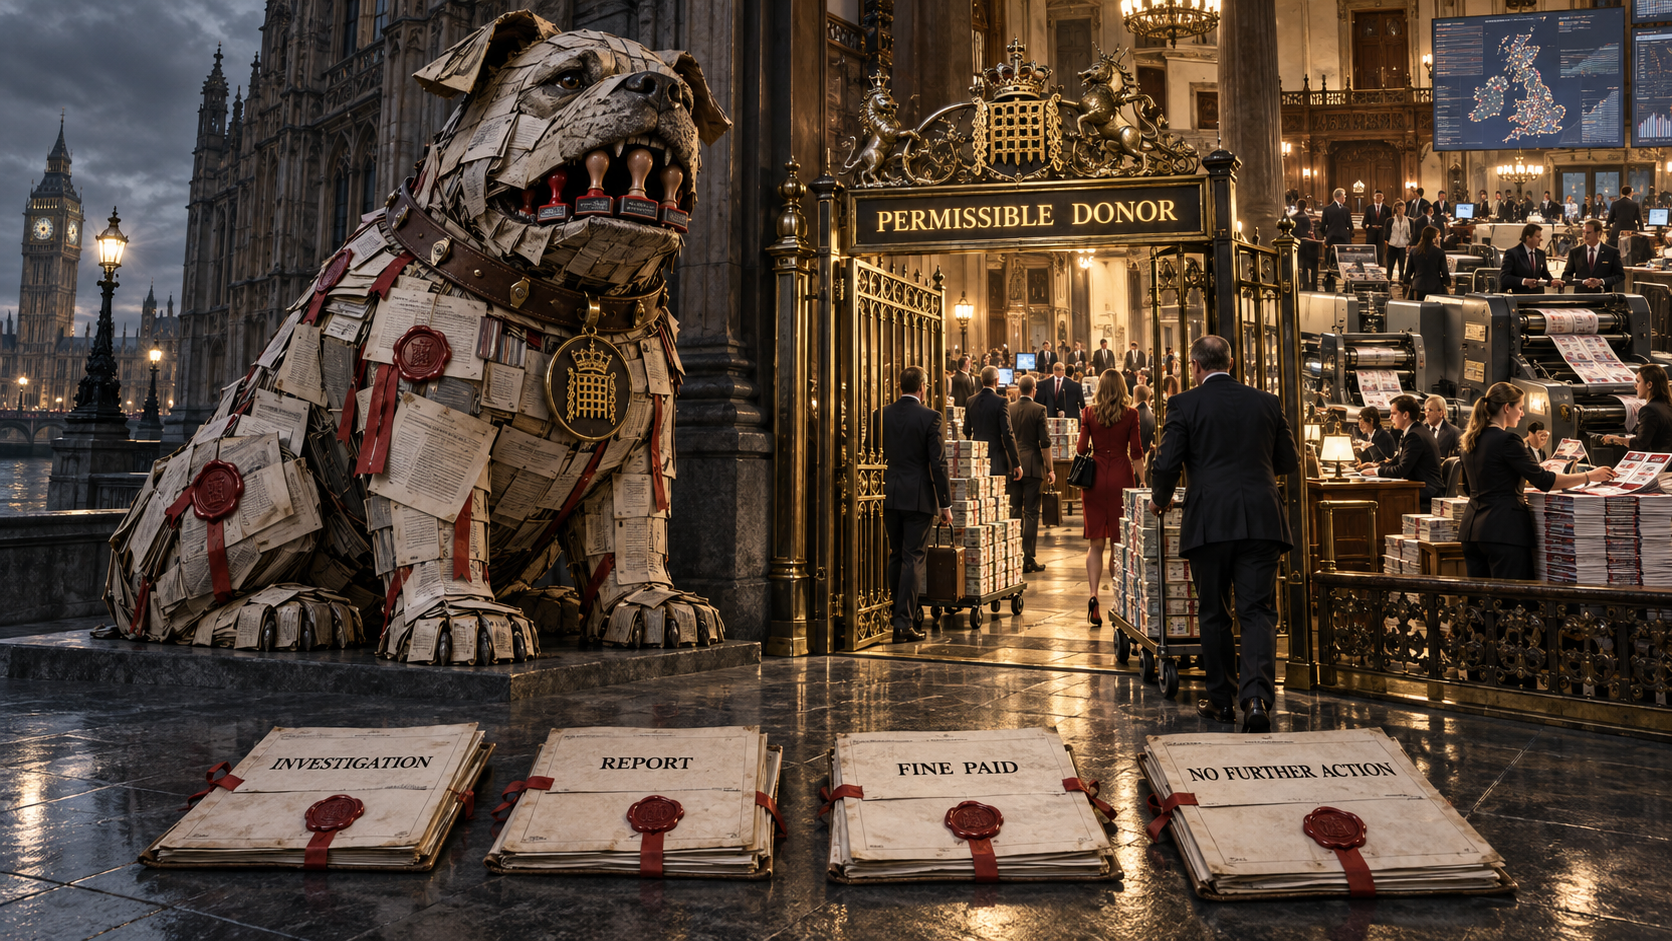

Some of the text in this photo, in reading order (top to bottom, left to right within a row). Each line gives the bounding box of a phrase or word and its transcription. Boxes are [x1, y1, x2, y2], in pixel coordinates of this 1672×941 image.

[875, 199, 1178, 231] PERMISSIBLE DONOR
[269, 755, 433, 771] INVESTIGATION
[599, 756, 693, 770] REPORT
[897, 761, 1019, 776] FINE PAID
[1188, 762, 1396, 782] NO FURTHER ACTION
